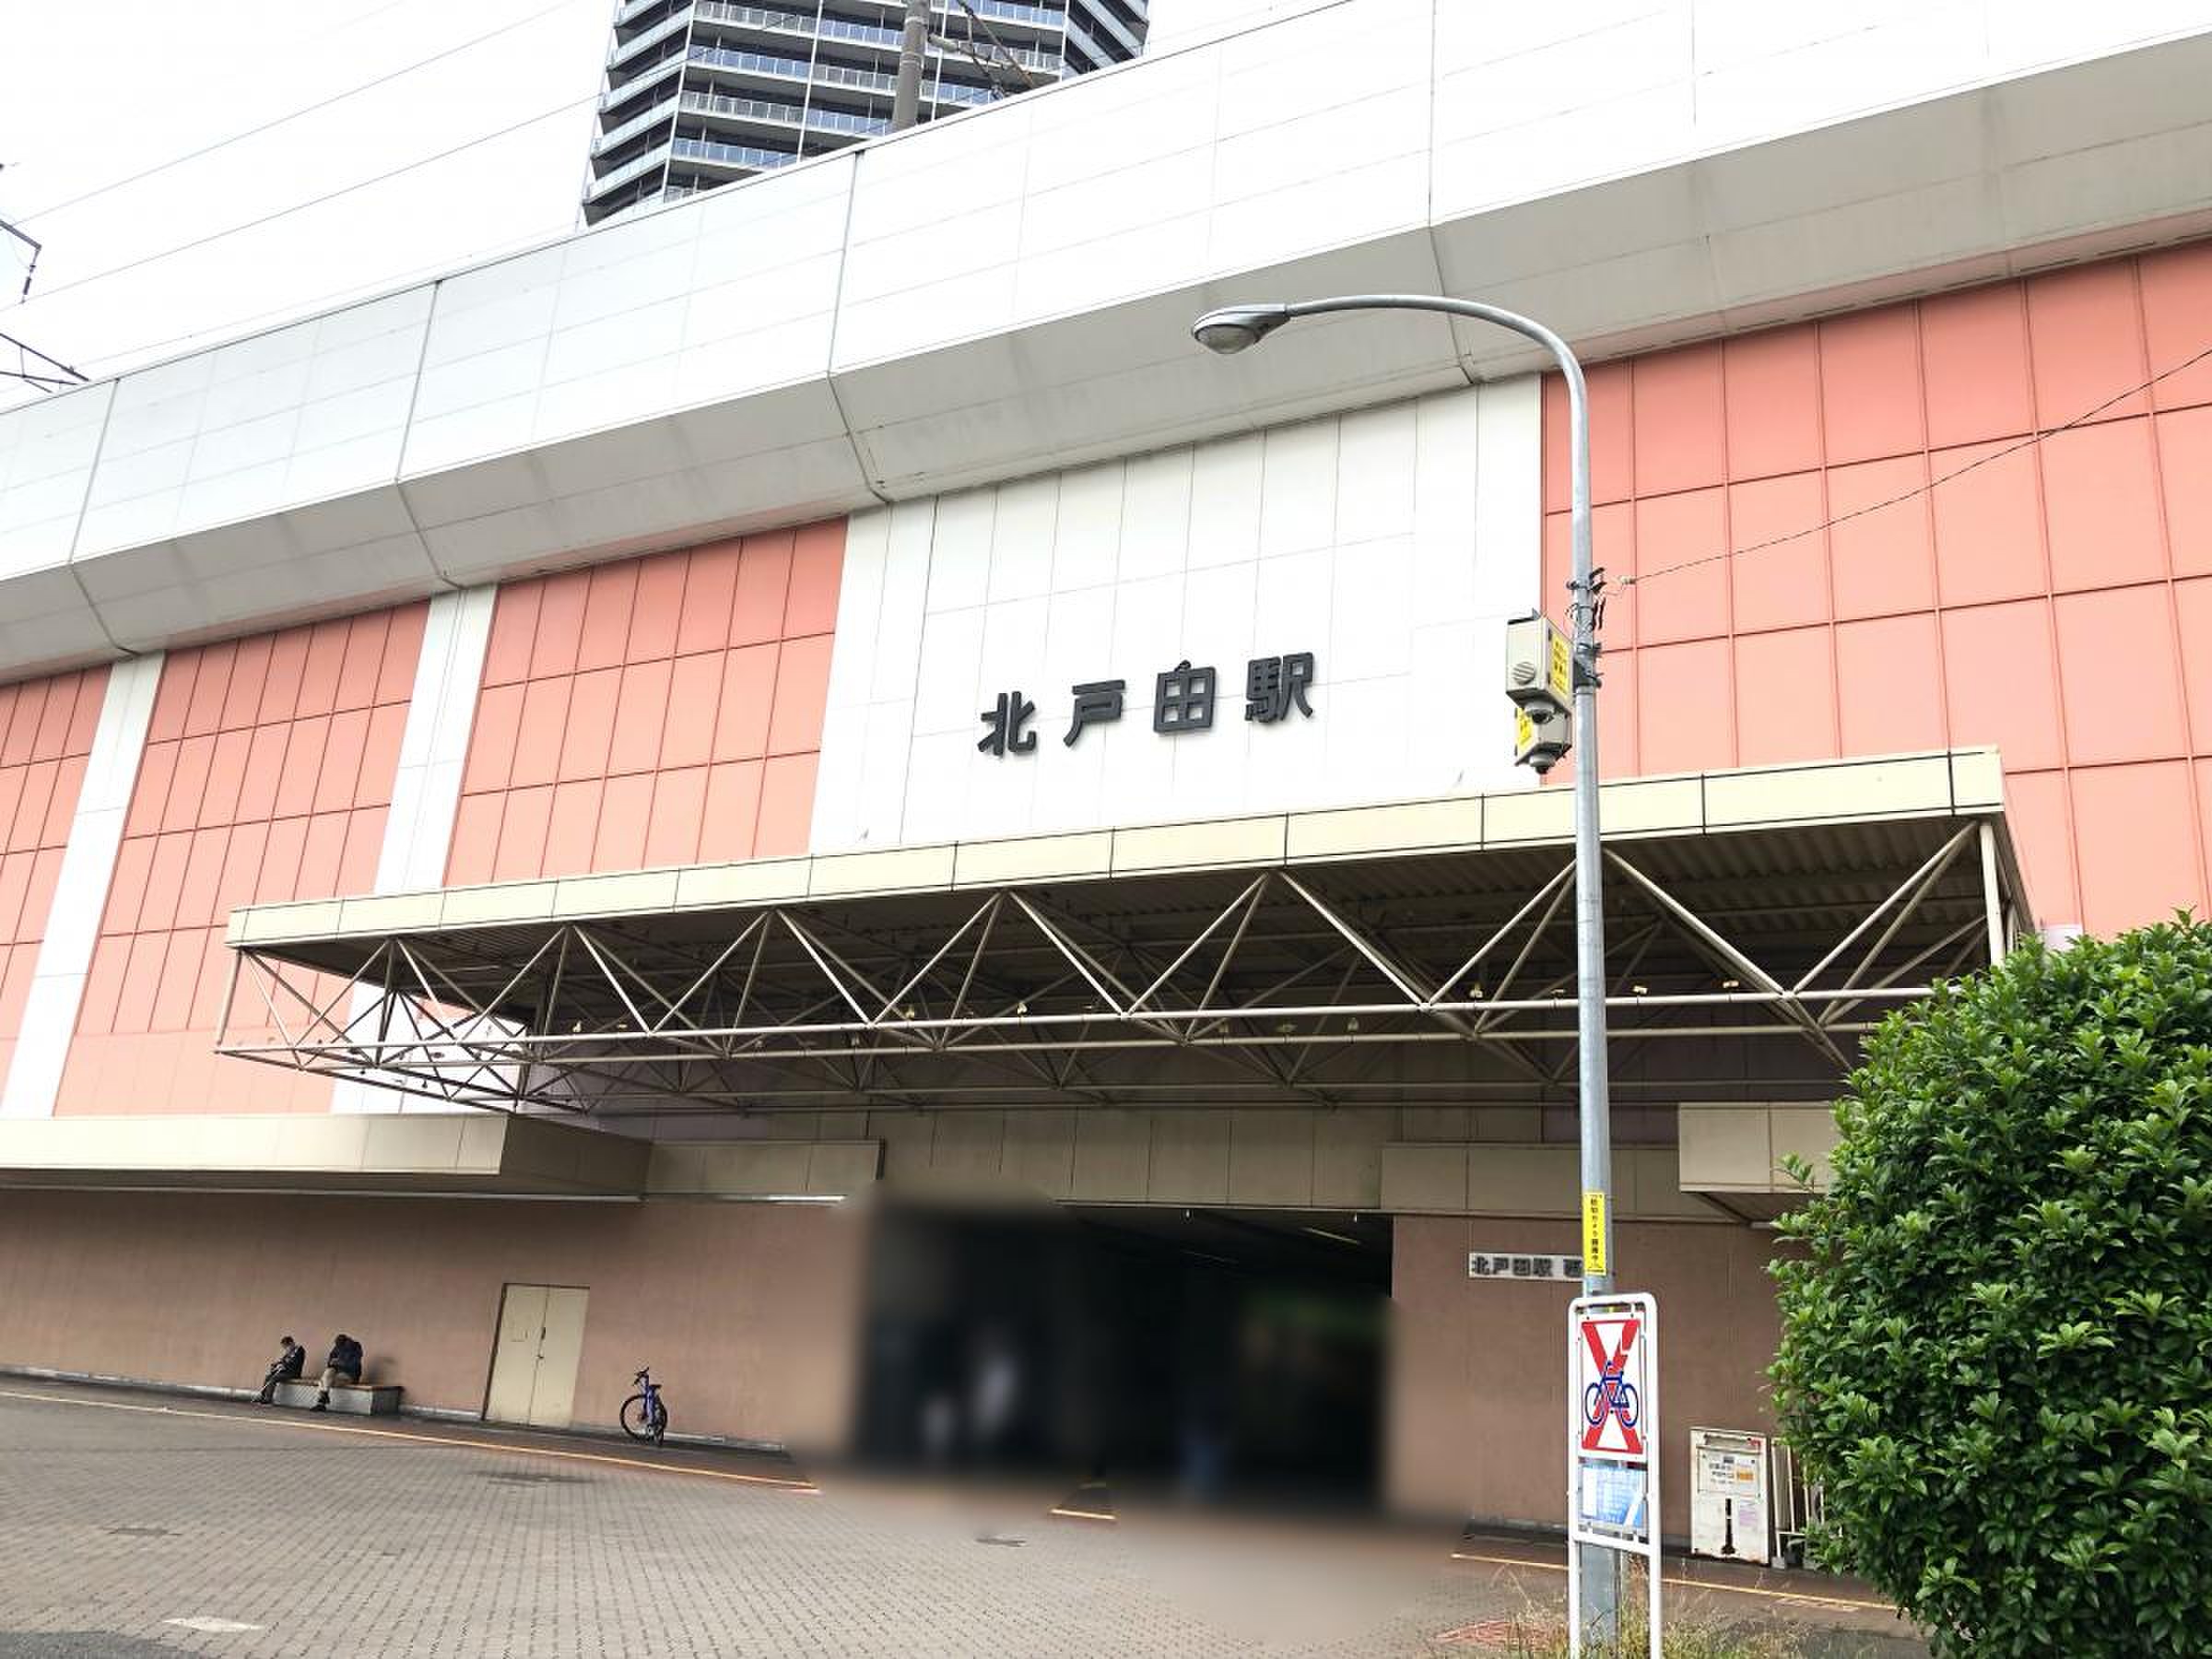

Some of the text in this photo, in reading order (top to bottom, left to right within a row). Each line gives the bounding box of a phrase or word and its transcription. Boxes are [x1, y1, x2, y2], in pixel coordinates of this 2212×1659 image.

[978, 652, 1313, 758] 北戸田駅
[1472, 1256, 1553, 1277] 北戸田駅
